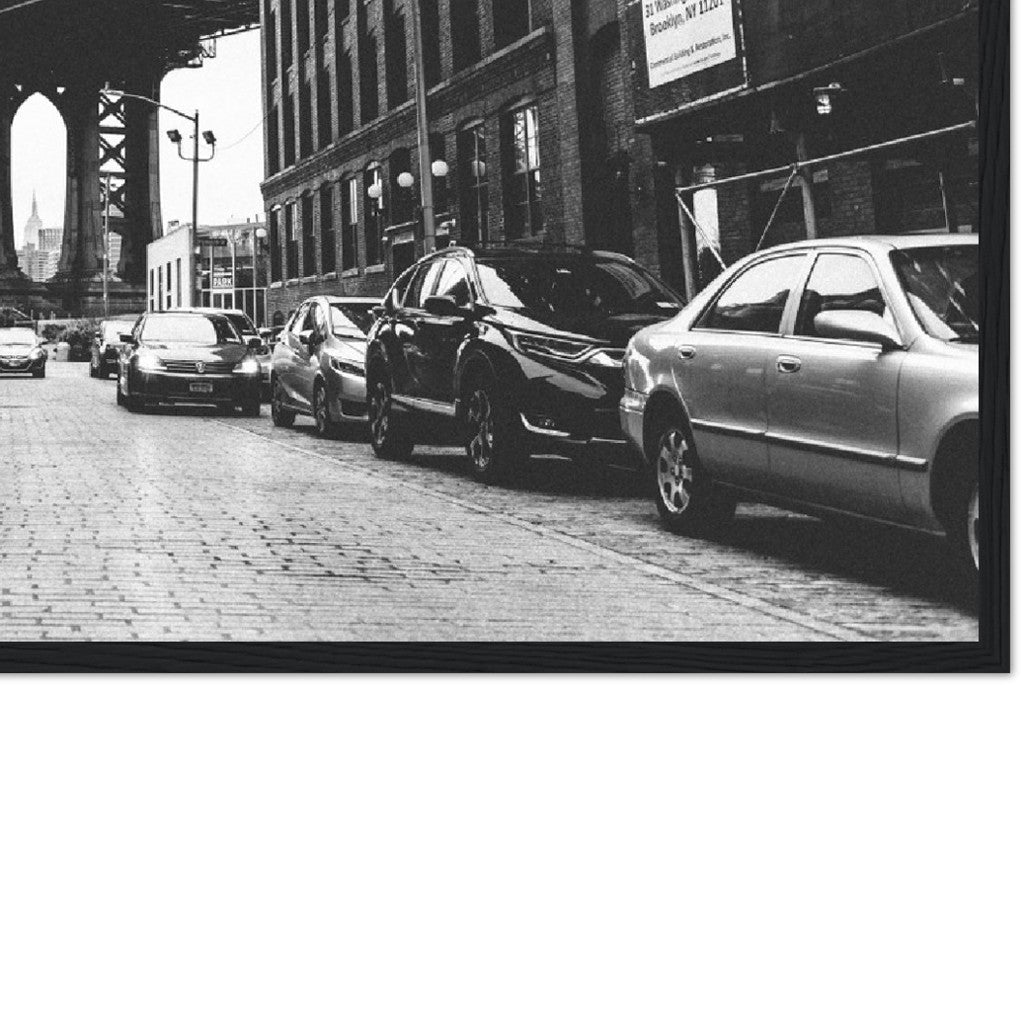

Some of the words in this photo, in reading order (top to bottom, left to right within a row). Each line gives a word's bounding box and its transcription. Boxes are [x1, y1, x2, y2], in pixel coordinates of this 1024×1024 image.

[645, 3, 654, 19] 31
[649, 13, 685, 36] Brooklyn,
[685, 3, 696, 21] NY
